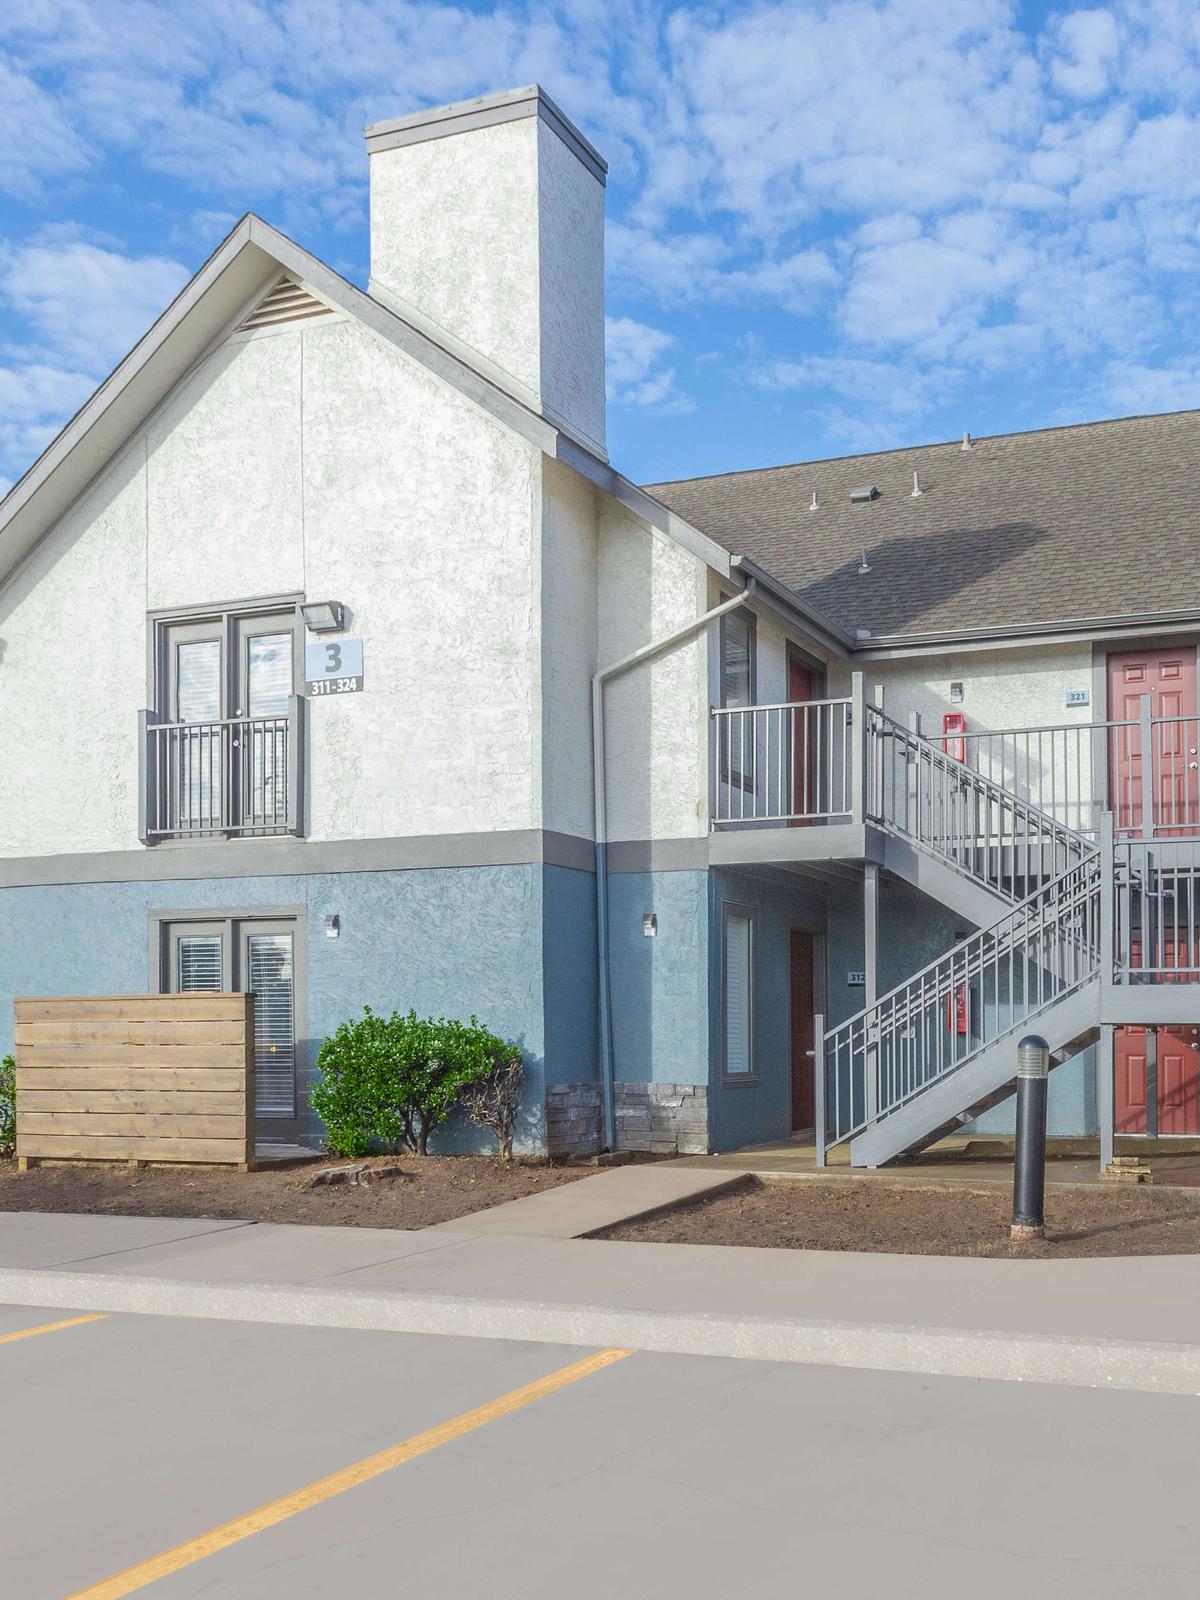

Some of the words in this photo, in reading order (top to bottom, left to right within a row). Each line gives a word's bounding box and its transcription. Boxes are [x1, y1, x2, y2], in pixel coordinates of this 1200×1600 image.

[325, 643, 342, 673] 3
[312, 677, 357, 695] 311-324
[1069, 693, 1086, 701] 321
